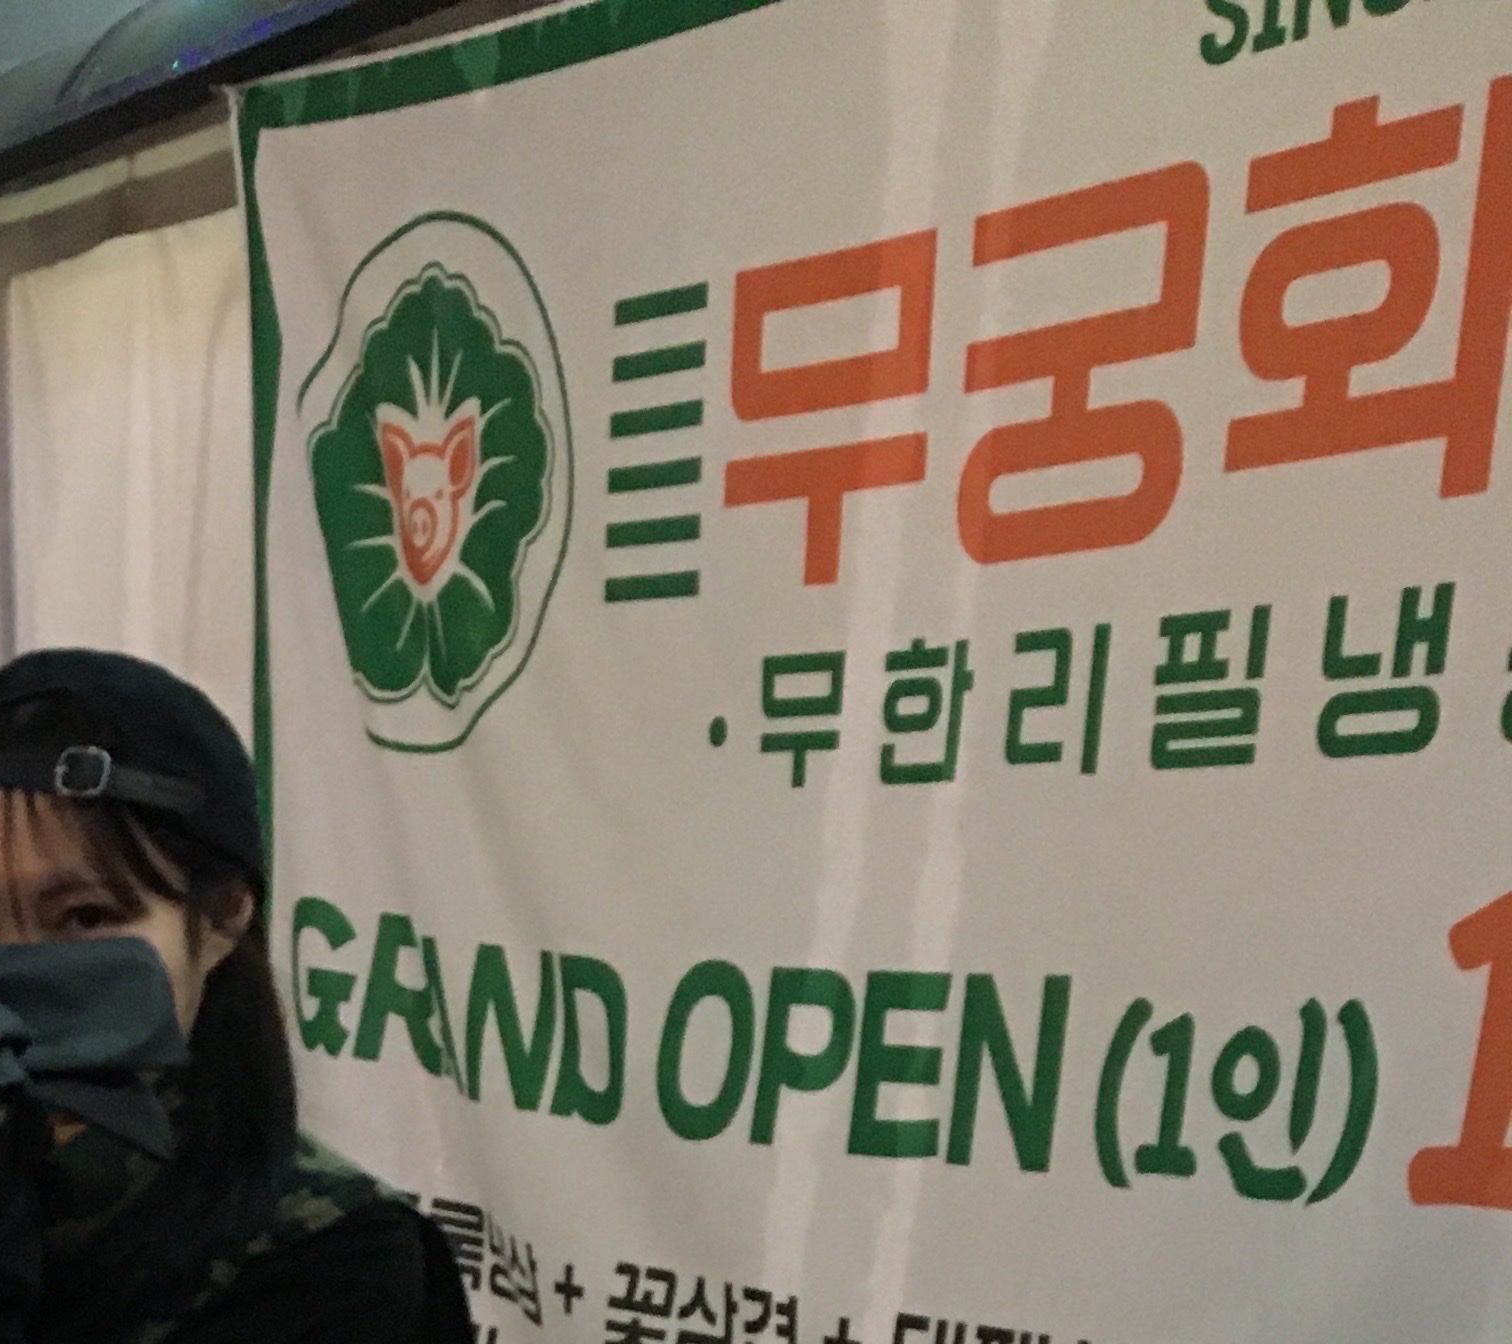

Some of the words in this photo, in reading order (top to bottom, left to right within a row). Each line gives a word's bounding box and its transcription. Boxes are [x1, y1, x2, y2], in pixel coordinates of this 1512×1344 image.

[723, 73, 1512, 587] 무궁화
[657, 959, 1072, 1173] OPEN
[1095, 998, 1379, 1205] (1인)
